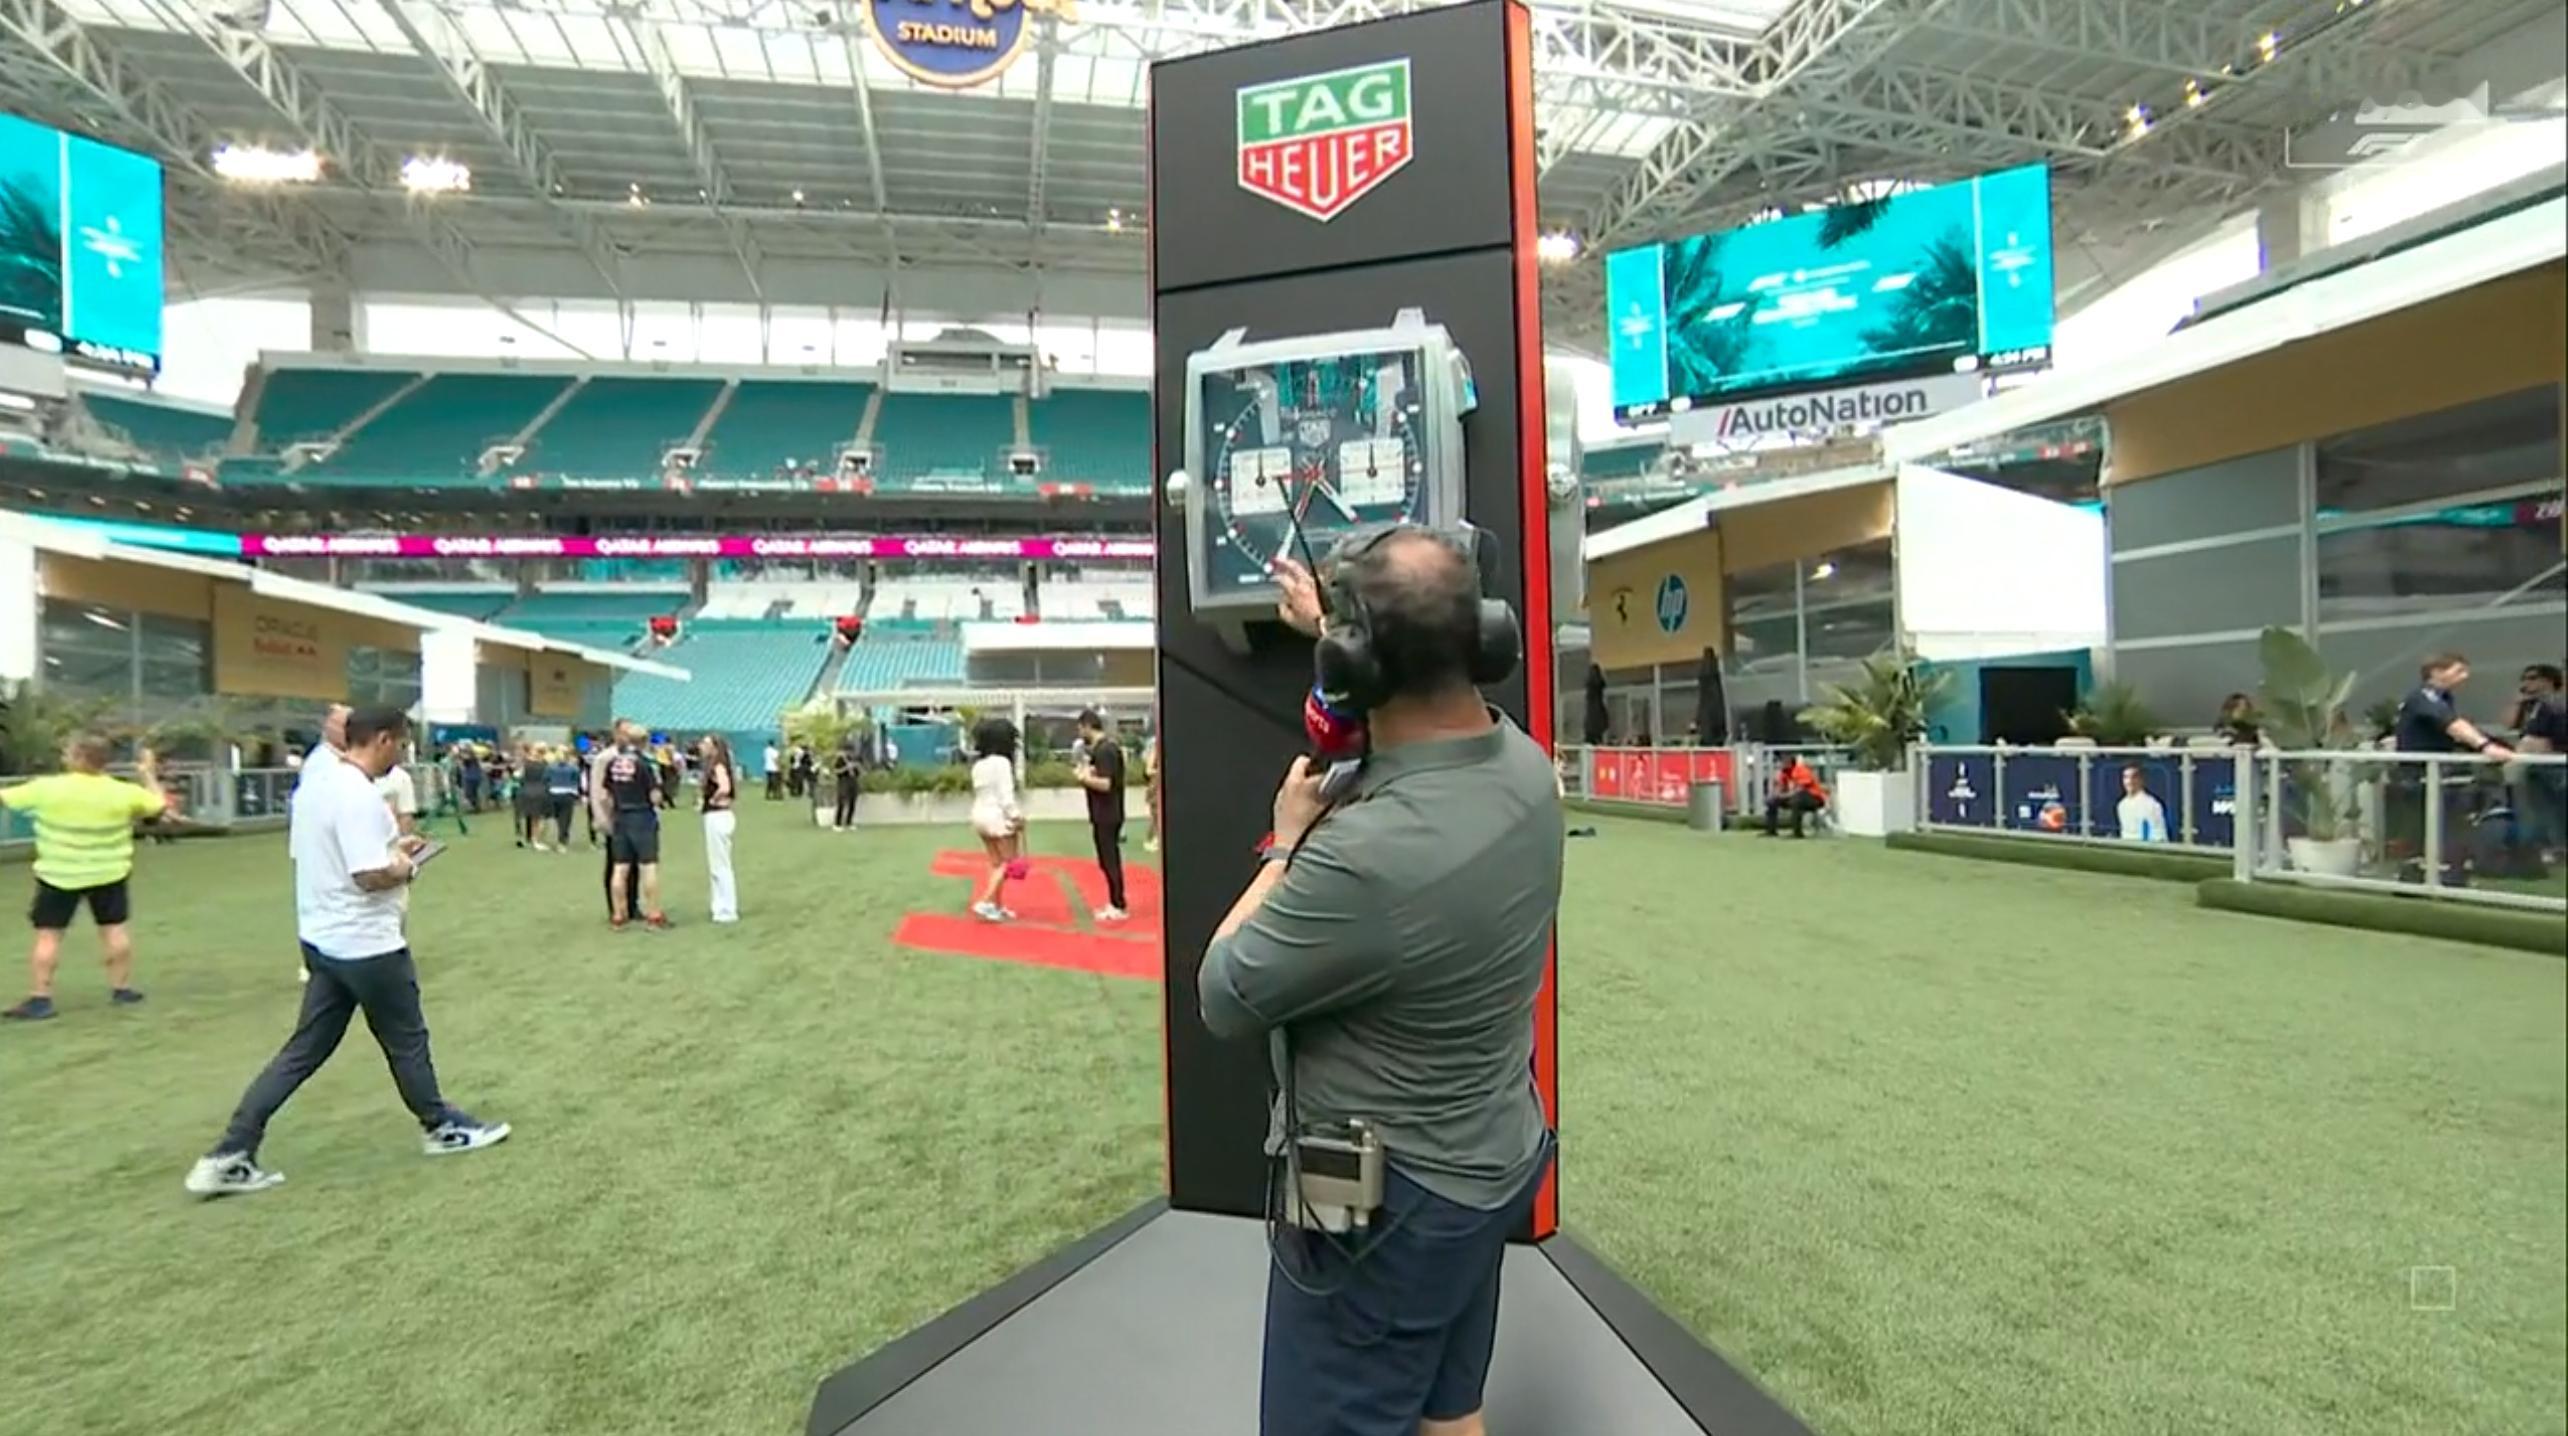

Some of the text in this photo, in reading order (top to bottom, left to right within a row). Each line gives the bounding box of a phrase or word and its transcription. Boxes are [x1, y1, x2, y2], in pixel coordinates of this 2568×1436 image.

[897, 20, 997, 48] STADIUM
[1252, 74, 1394, 135] TAG
[1248, 128, 1401, 208] HEUER
[1728, 390, 1927, 436] AutoNation
